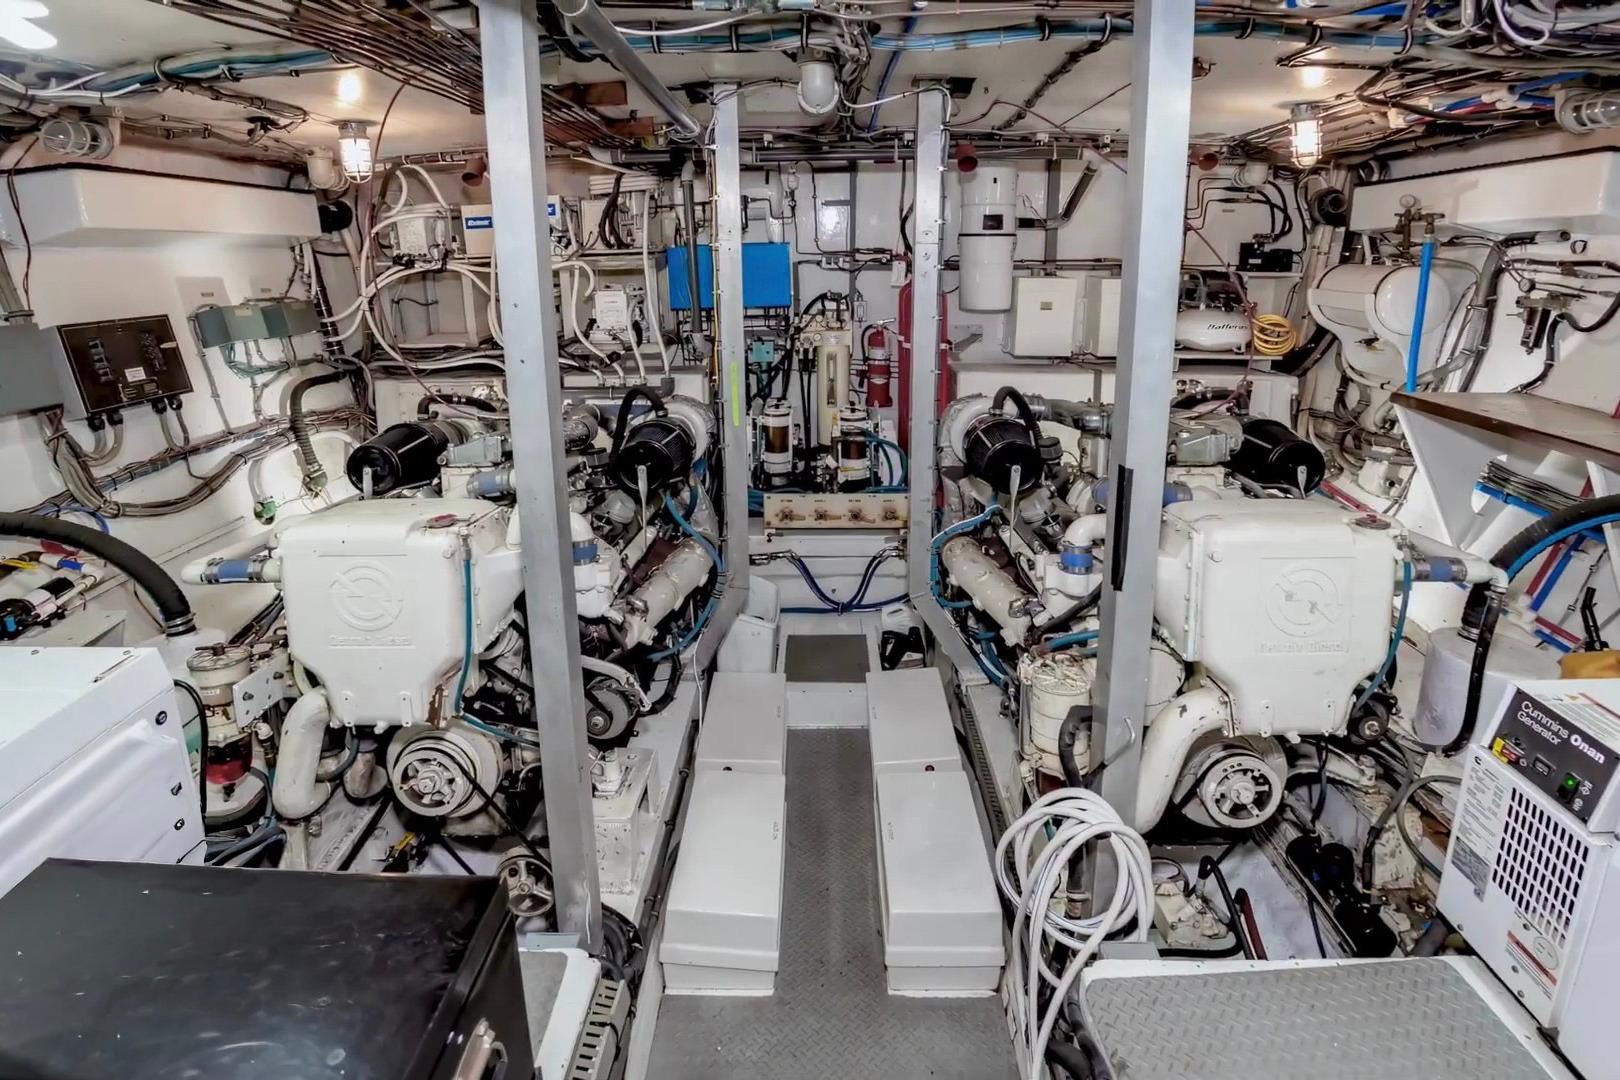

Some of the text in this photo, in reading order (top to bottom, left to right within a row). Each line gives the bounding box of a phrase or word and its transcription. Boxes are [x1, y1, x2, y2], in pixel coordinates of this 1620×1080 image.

[1517, 711, 1562, 745] Generator
[1521, 701, 1569, 739] Cummins
[1570, 734, 1605, 764] Onan
